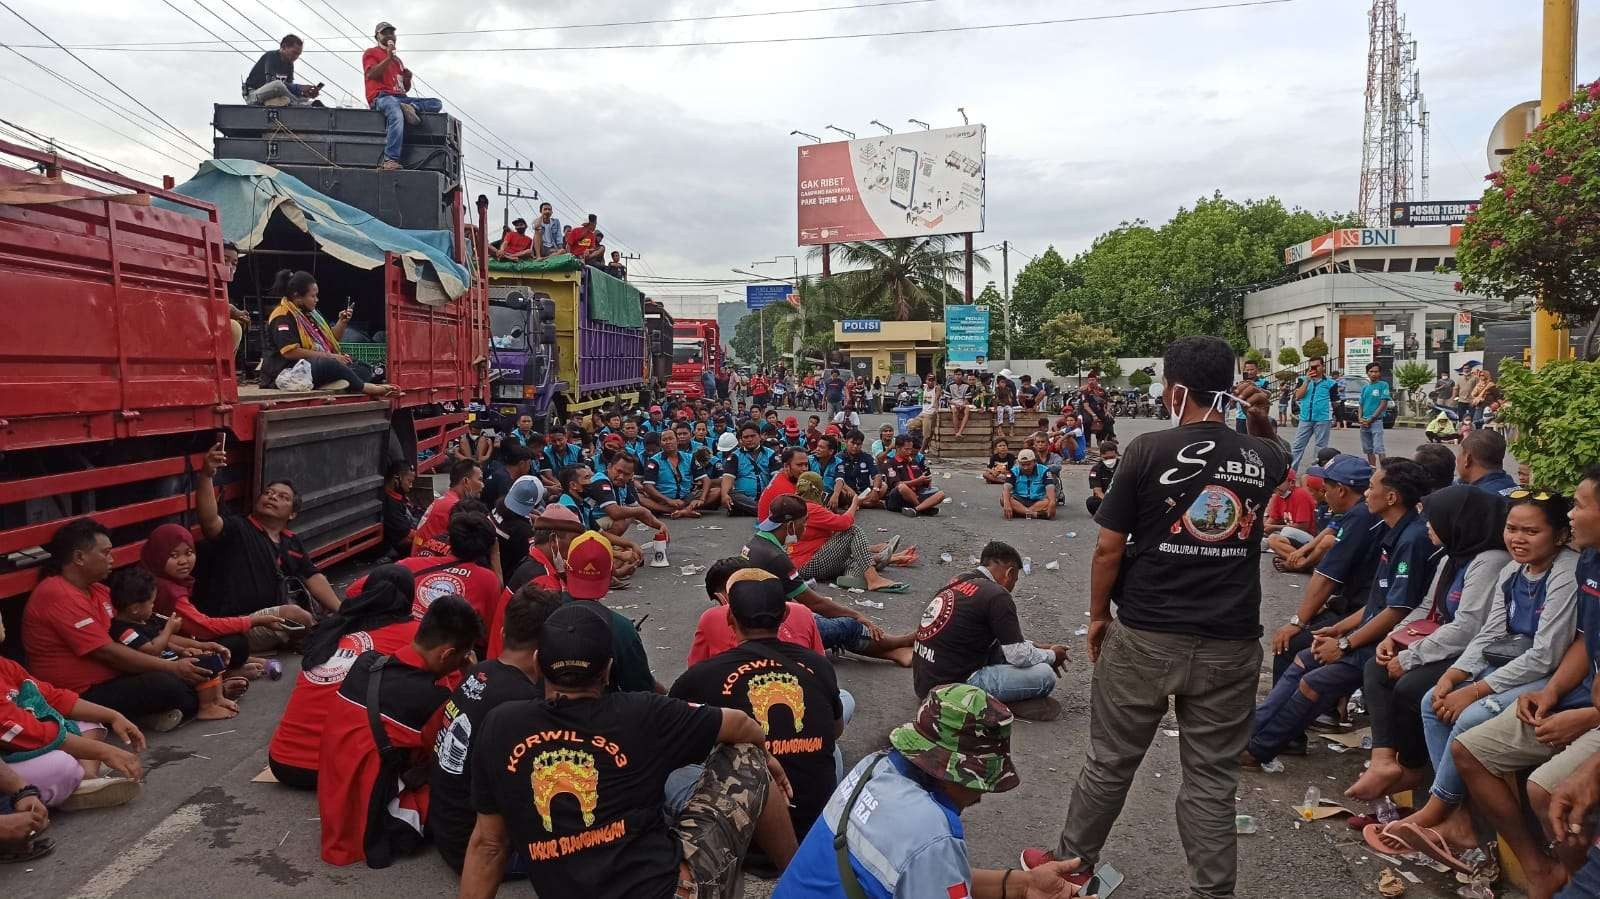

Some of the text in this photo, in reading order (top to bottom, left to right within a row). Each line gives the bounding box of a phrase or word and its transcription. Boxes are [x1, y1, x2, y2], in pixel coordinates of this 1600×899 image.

[800, 176, 844, 189] GAK RIBET
[800, 198, 817, 206] PAKE
[1409, 205, 1440, 215] POSKO
[1362, 229, 1396, 246] BNI
[1292, 245, 1303, 261] BNI
[844, 321, 879, 330] POLISI
[1213, 472, 1266, 488] anyuwangi
[1158, 542, 1199, 556] SEDULURAN
[1200, 546, 1222, 557] TANPA
[507, 730, 628, 773] KORWIL 333
[772, 736, 823, 755] BLAMBANGAN
[560, 819, 626, 856] BLAMBANGAN
